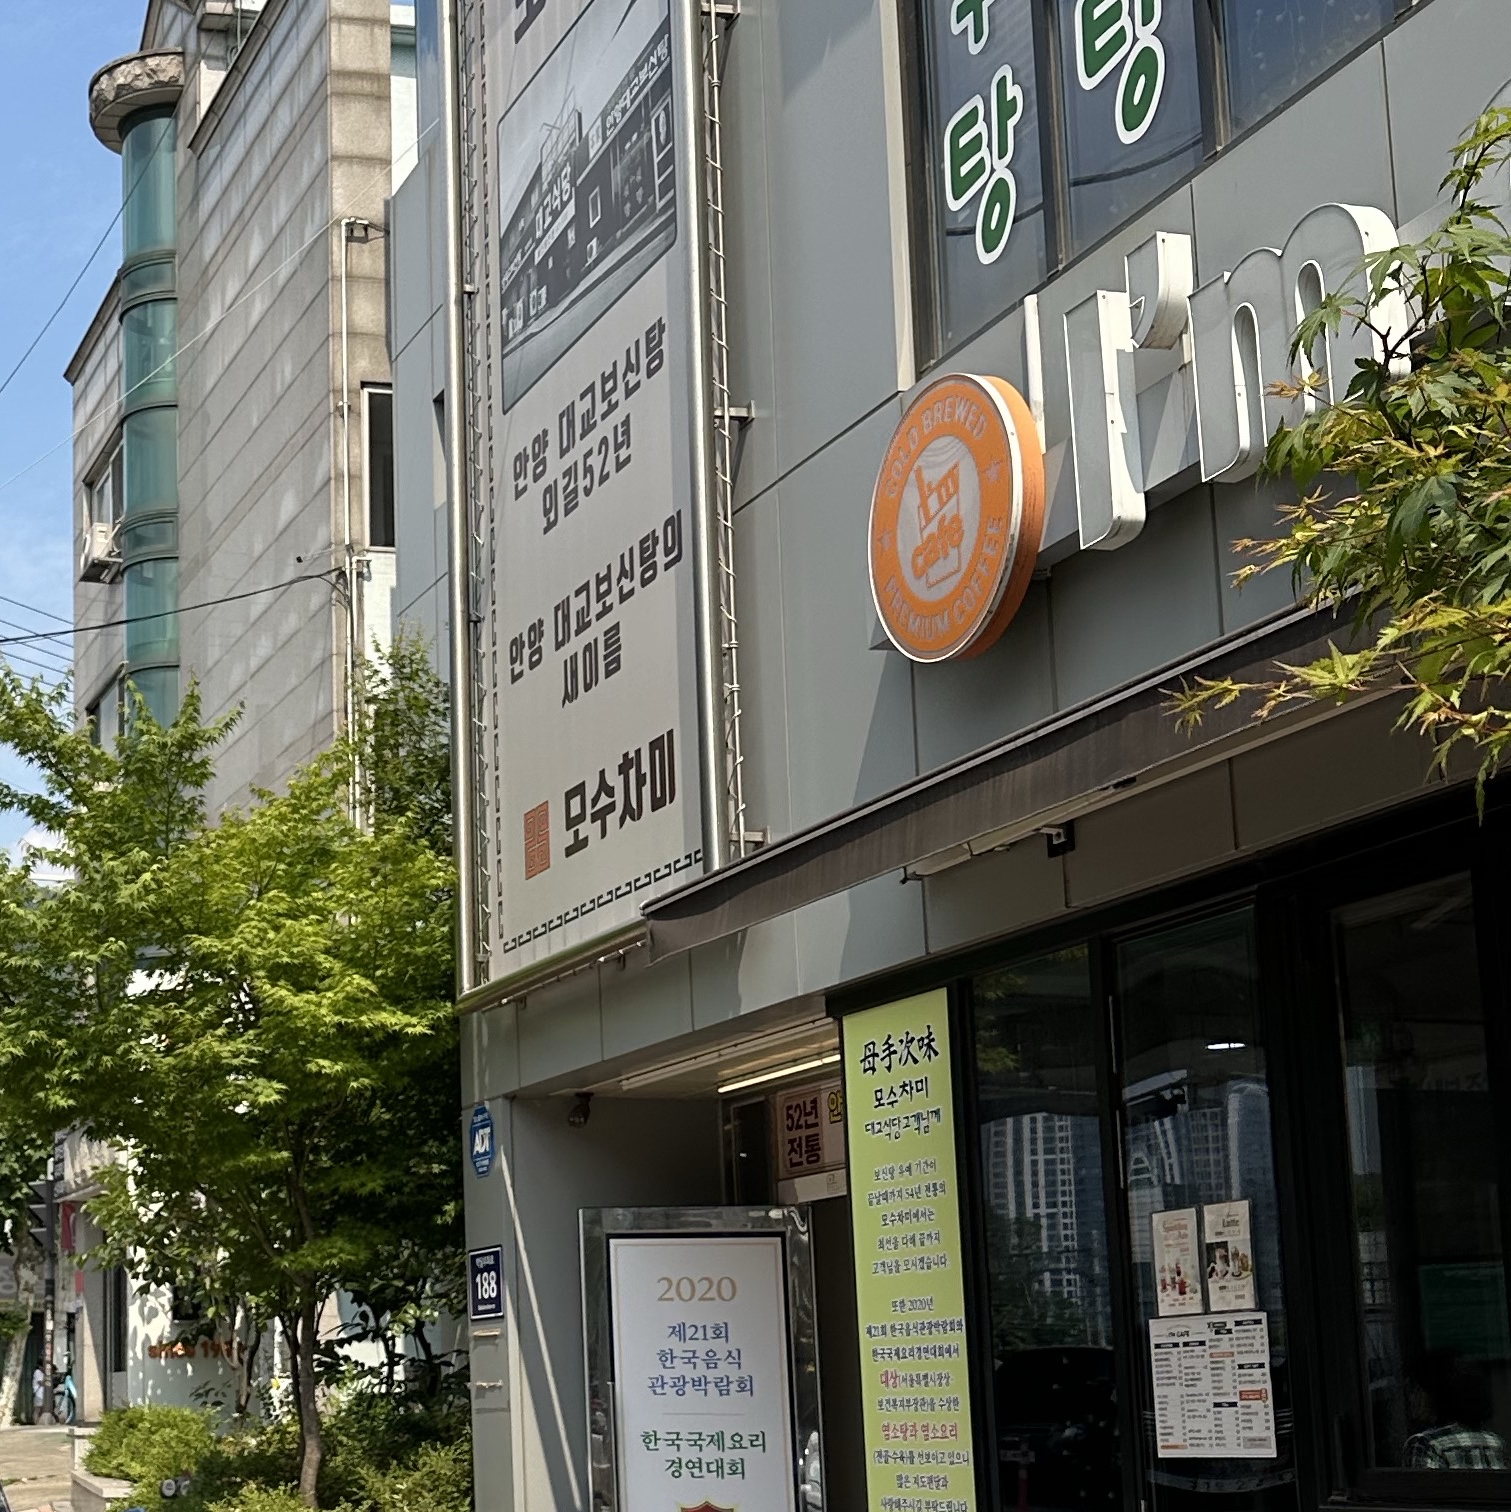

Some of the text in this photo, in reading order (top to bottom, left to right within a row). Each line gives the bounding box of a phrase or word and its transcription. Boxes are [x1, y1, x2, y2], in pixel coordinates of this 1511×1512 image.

[513, 316, 666, 501] 안양 대교보신탕
[922, 396, 988, 440] BREWED
[542, 412, 632, 535] 외길52년
[885, 516, 1003, 642] PREMIUM COFFEE
[509, 508, 683, 685] 안양 대교보신탕의
[562, 620, 622, 709] 새이름
[564, 728, 677, 859] 모수차미
[873, 1076, 929, 1109] 모수차미
[785, 1097, 820, 1132] 52년
[474, 1127, 491, 1155] ADT
[787, 1133, 821, 1169] 전통
[475, 1270, 497, 1300] 188
[656, 1275, 737, 1302] 2020
[667, 1321, 730, 1344] 제21회
[656, 1348, 743, 1371] 한국음식
[647, 1374, 755, 1397] 관광박람회
[641, 1429, 767, 1454] 한국국제요리
[664, 1456, 747, 1481] 경연대회
